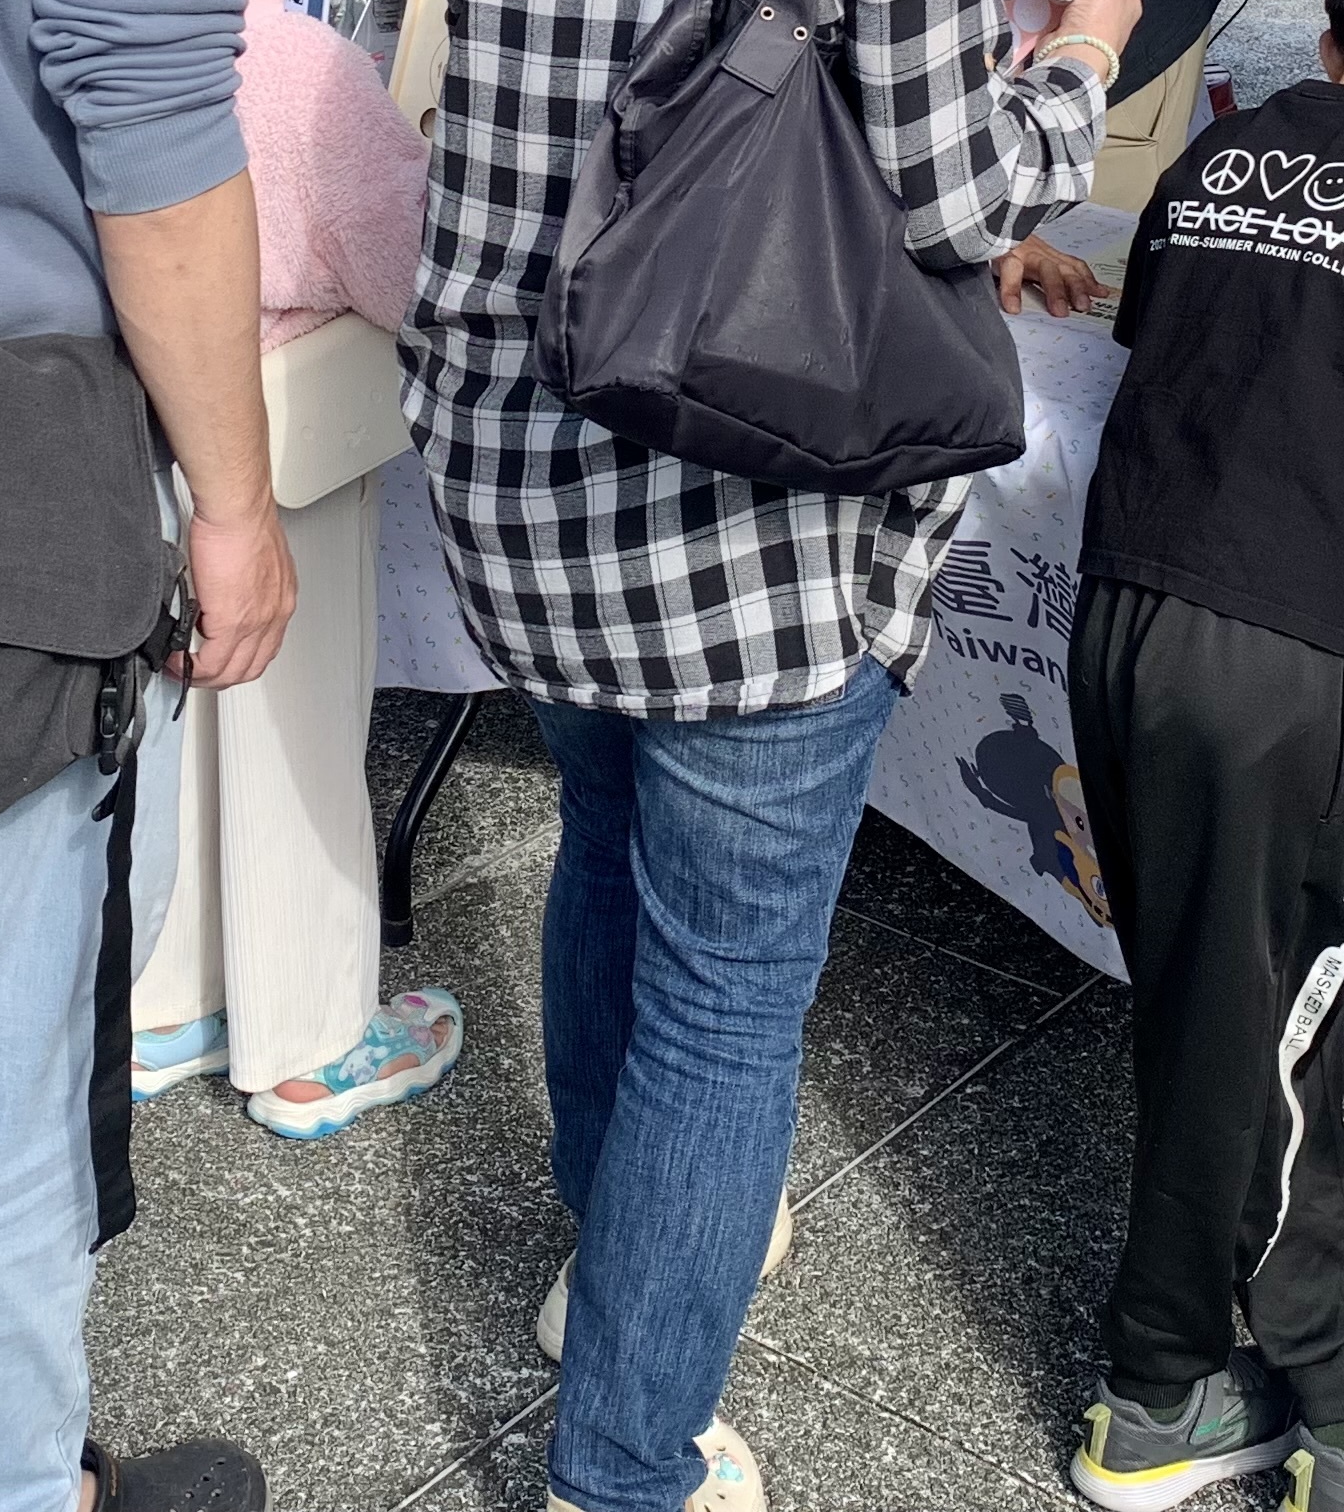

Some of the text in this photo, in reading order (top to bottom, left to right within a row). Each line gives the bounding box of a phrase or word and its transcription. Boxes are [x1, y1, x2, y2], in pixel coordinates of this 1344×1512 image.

[1167, 200, 1267, 235] PEACE
[1168, 233, 1253, 253] RING-SUMMER
[1255, 242, 1301, 263] NIXXIN
[1285, 955, 1342, 1051] MASKED BALL
